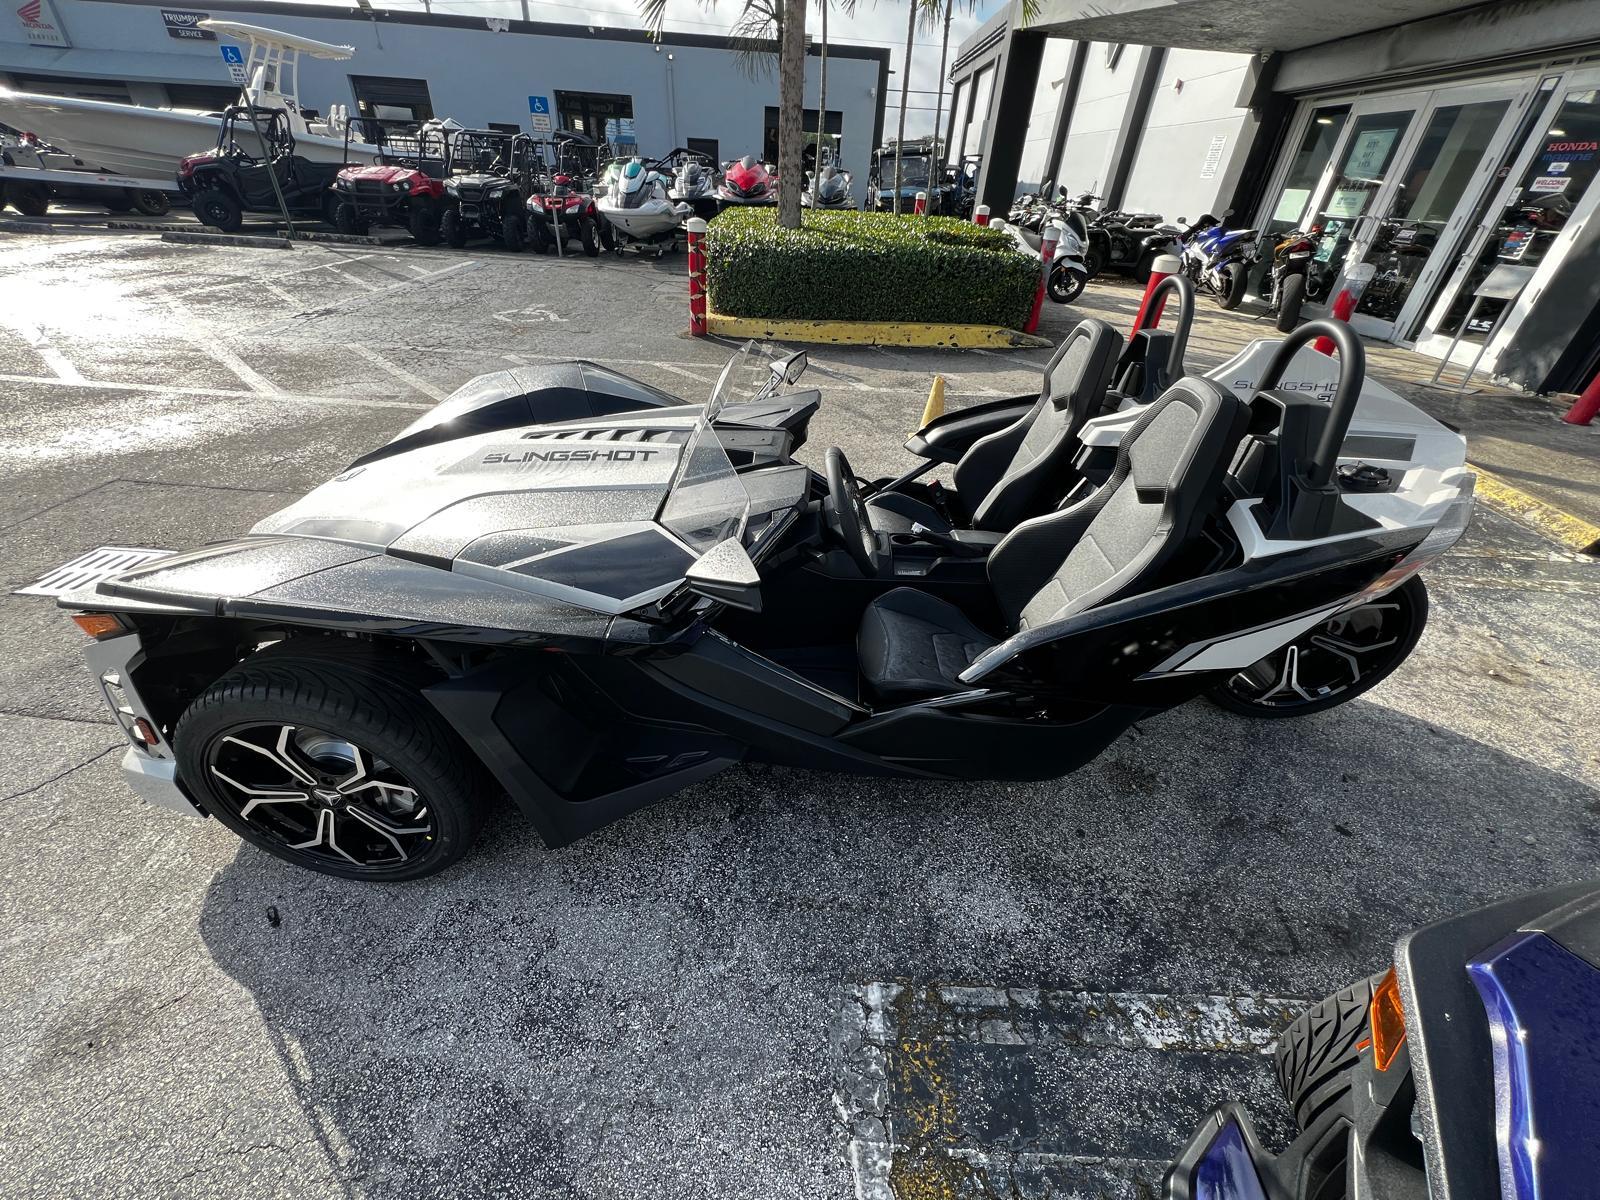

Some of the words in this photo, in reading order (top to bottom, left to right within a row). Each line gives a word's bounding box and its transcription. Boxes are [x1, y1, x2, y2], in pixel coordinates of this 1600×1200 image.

[163, 13, 199, 22] TRIUMPH
[22, 21, 55, 30] HONDA
[178, 29, 203, 38] SERVICE
[1547, 142, 1598, 151] HONDA
[482, 450, 659, 464] SLINGSHOT
